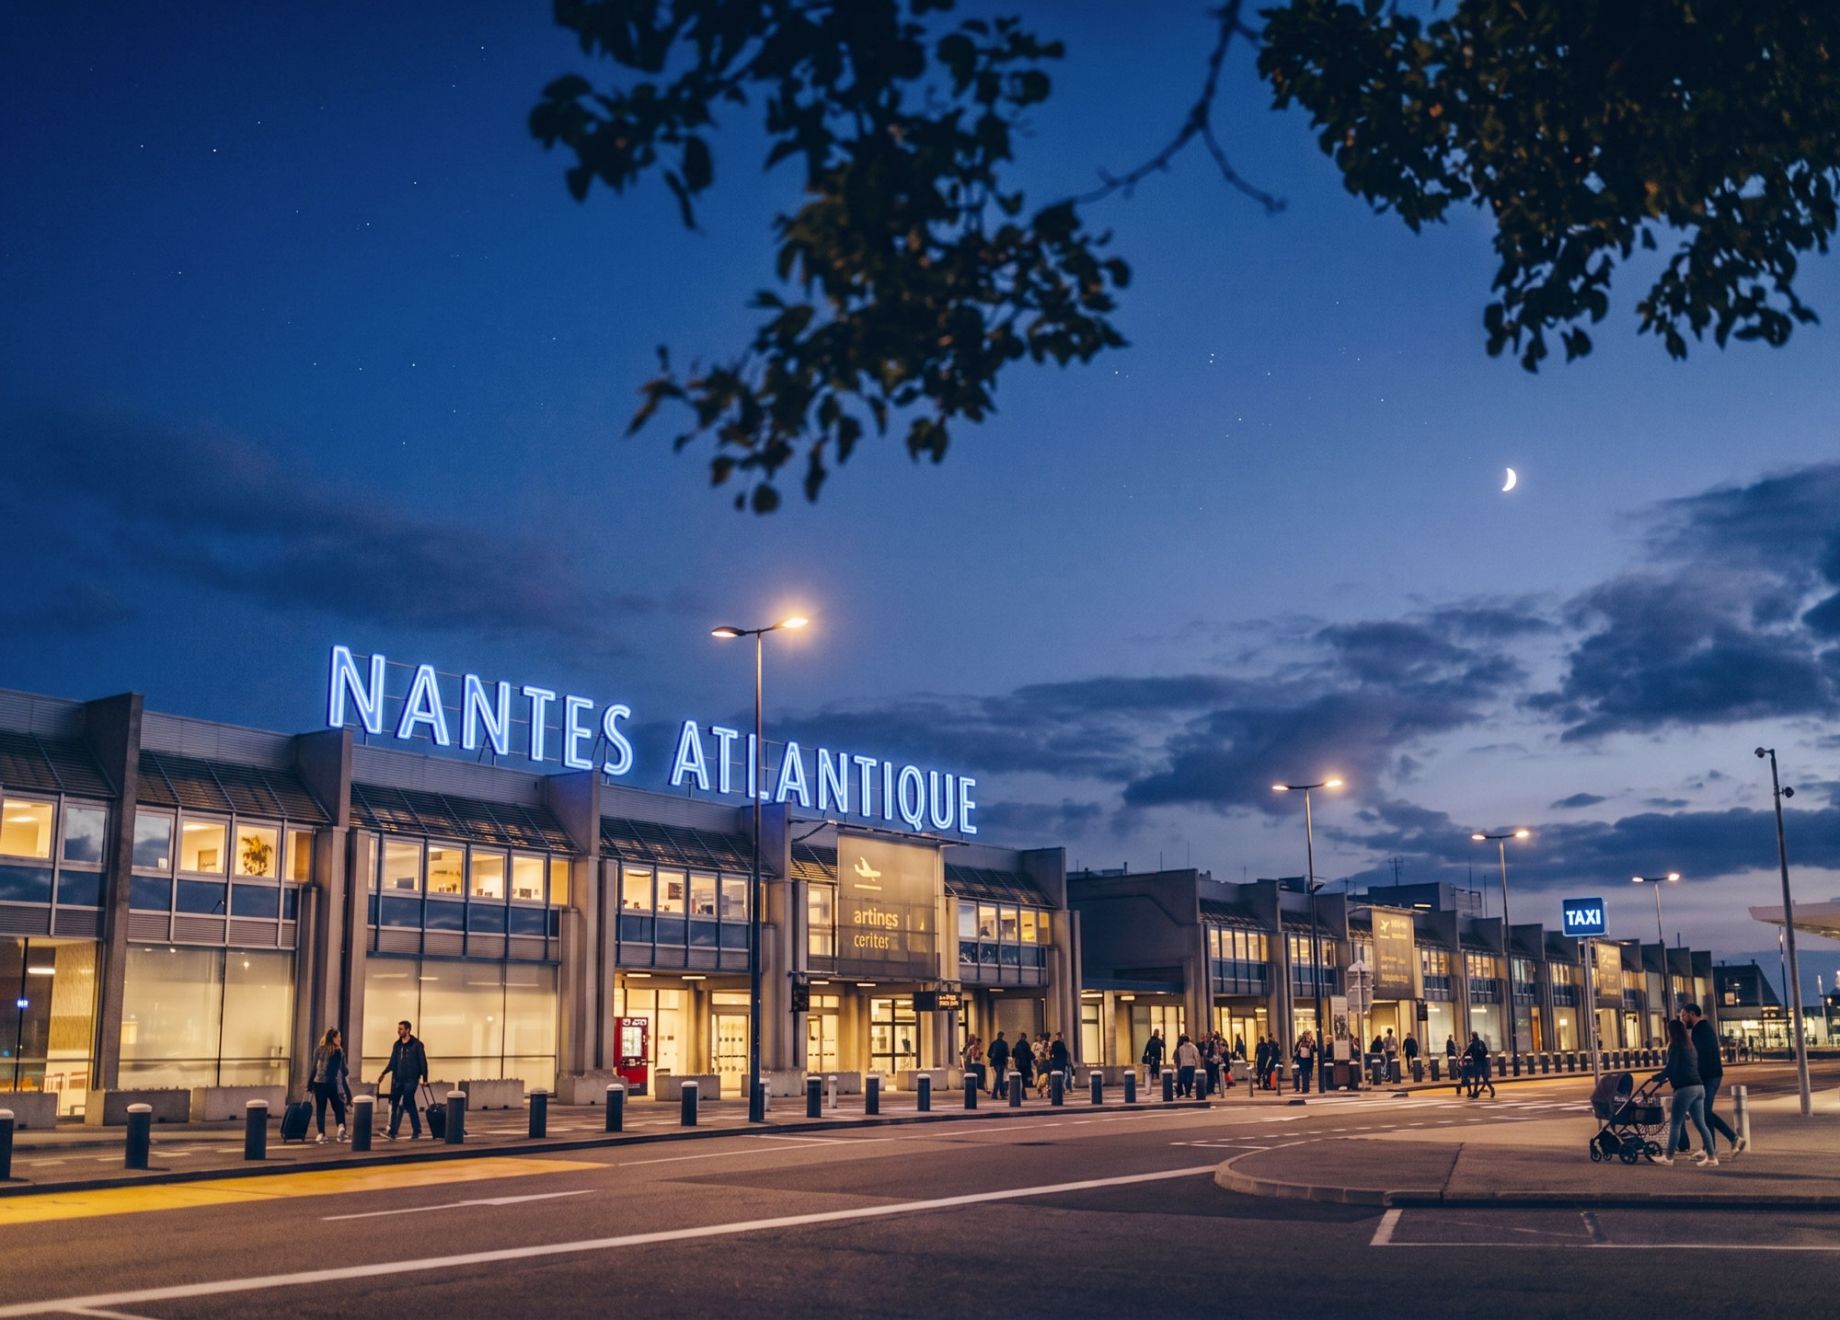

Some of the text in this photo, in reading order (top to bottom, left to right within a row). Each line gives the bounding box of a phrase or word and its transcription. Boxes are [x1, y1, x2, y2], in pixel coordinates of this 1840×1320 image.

[328, 645, 977, 834] NANTES ATLANTIQUE
[1566, 909, 1601, 925] TAXI
